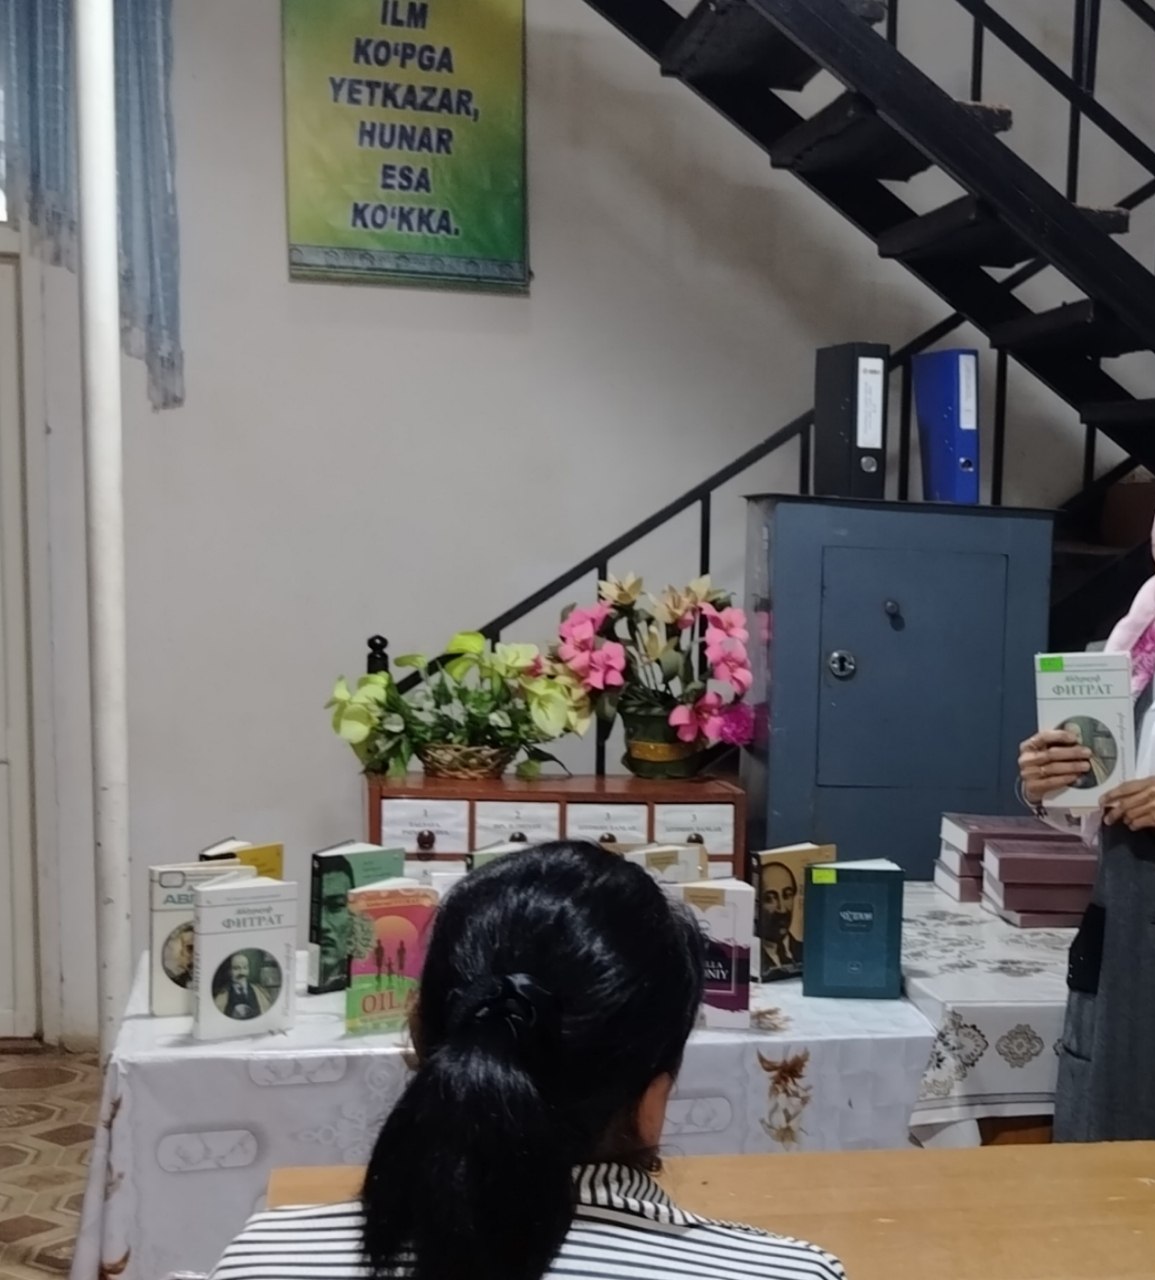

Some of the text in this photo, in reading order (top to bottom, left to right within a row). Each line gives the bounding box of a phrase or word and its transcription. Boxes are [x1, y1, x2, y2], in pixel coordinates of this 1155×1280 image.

[380, 0, 429, 29] ILM
[329, 76, 480, 121] YETKAZAR,
[358, 121, 454, 155] HUNAR
[381, 164, 432, 193] ESA
[1052, 683, 1115, 696] ФИТРАТ
[221, 914, 285, 929] ФИТРАТ
